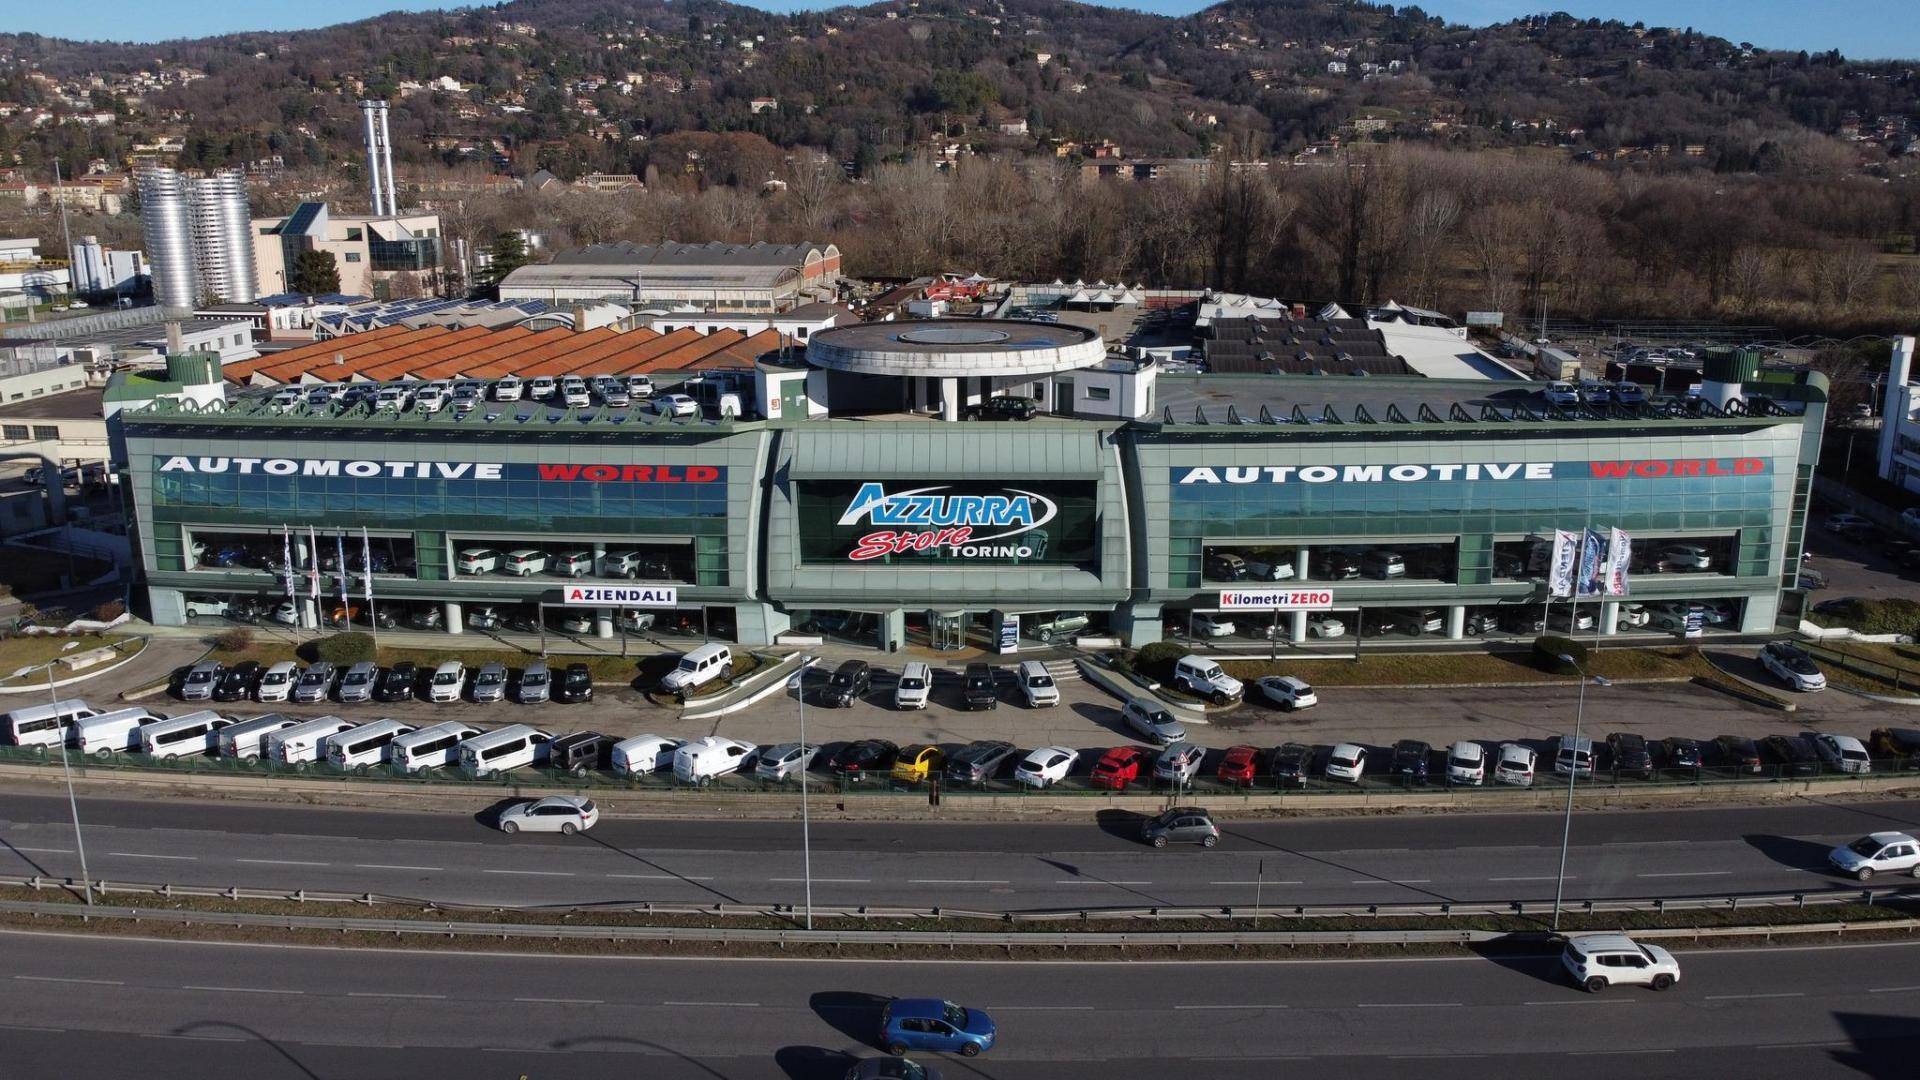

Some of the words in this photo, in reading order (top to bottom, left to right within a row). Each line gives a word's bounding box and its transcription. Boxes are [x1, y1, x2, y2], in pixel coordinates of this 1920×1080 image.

[159, 456, 503, 480] AUTOMOTIVE
[538, 464, 719, 482] WORLD
[1179, 463, 1553, 484] AUTOMOTIVE
[1589, 457, 1764, 478] WORLD
[837, 482, 1034, 526] AZZURRA
[848, 526, 973, 560] Store
[949, 545, 1032, 558] TORINO
[570, 589, 672, 602] AZIENDALI
[1222, 593, 1288, 605] Kilometri
[1290, 592, 1330, 604] ZERO
